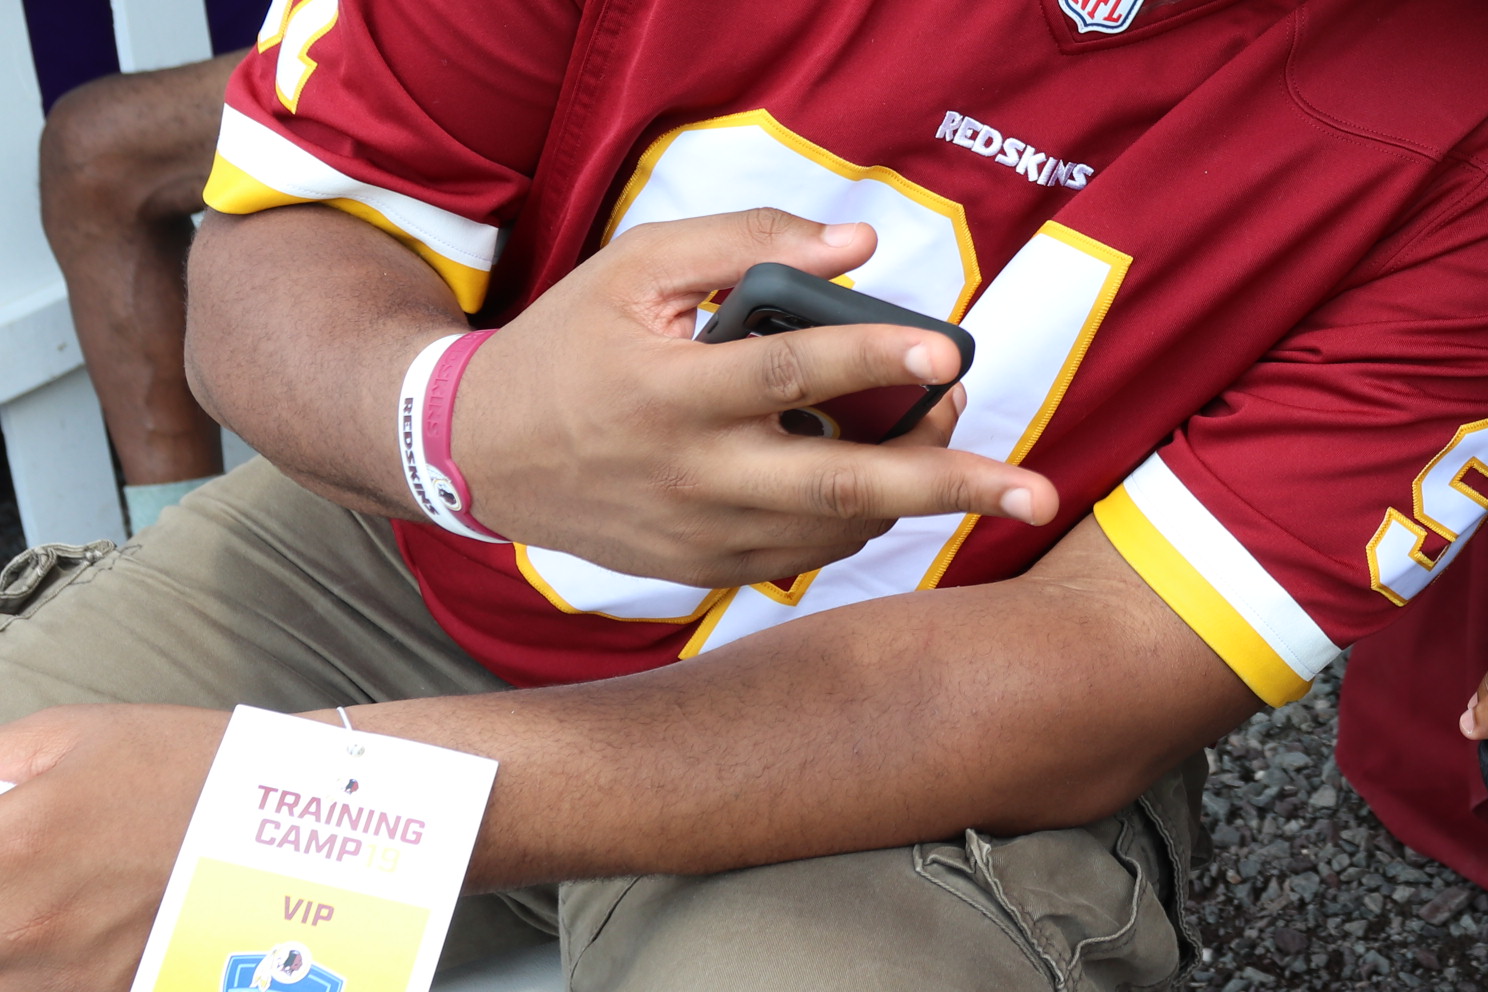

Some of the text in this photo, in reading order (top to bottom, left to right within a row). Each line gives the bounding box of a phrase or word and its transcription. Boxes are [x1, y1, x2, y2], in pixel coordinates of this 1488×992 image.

[935, 110, 1095, 190] REDSKINS
[402, 397, 440, 517] REDSKINS
[257, 784, 426, 846] TRAINING
[284, 895, 335, 927] VIP
